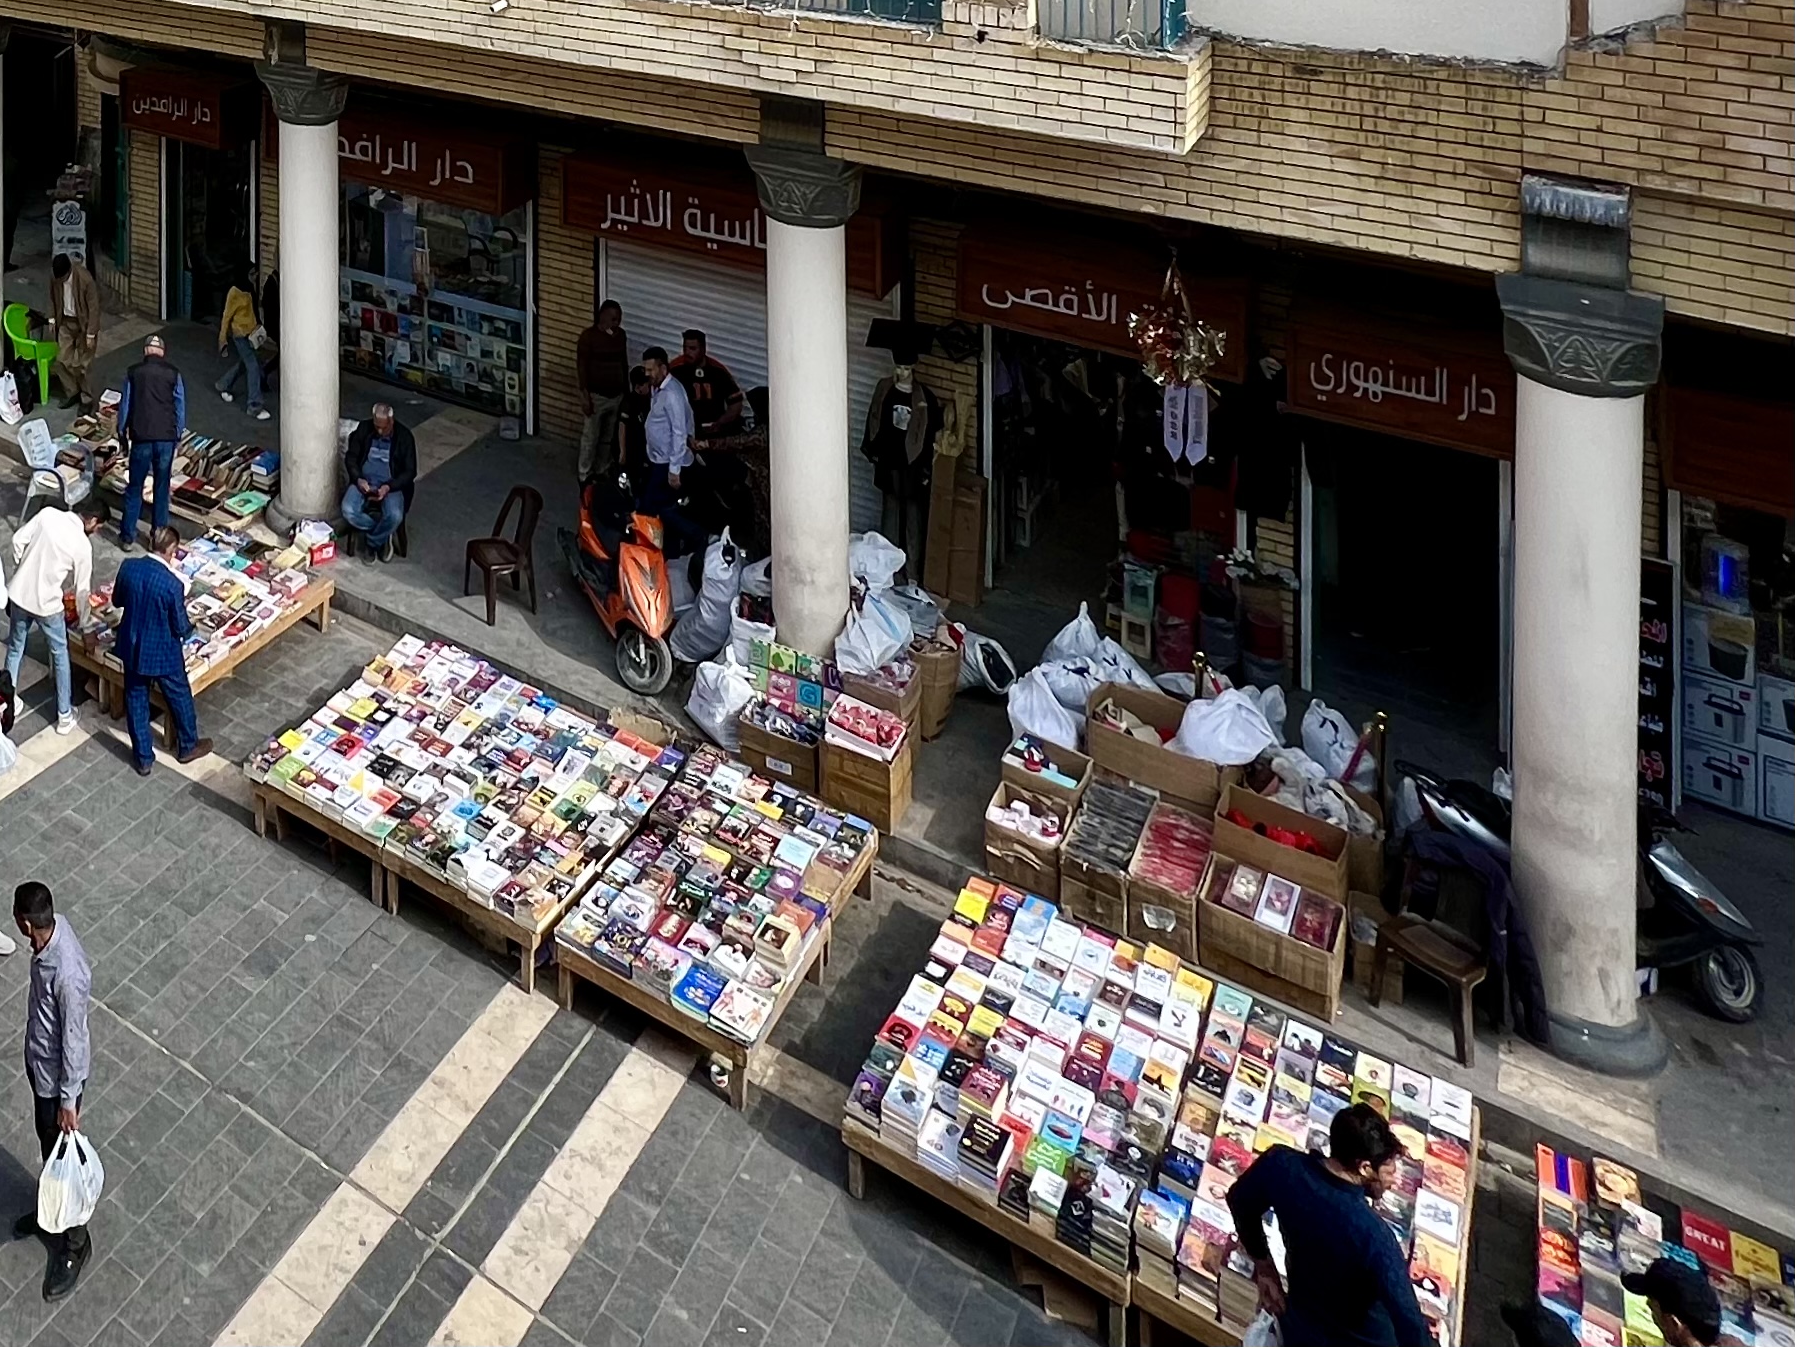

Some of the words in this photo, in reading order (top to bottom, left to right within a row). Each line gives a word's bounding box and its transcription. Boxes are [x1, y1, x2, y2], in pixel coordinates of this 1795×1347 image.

[132, 93, 188, 121] الرافدين
[191, 99, 211, 125] دار
[338, 133, 417, 176] الرافد
[429, 148, 474, 186] دار
[600, 179, 671, 232] الاثير
[683, 196, 767, 250] اسية
[980, 279, 1118, 325] الأقصى
[1309, 353, 1447, 405] السنهوري
[1457, 373, 1496, 421] دار
